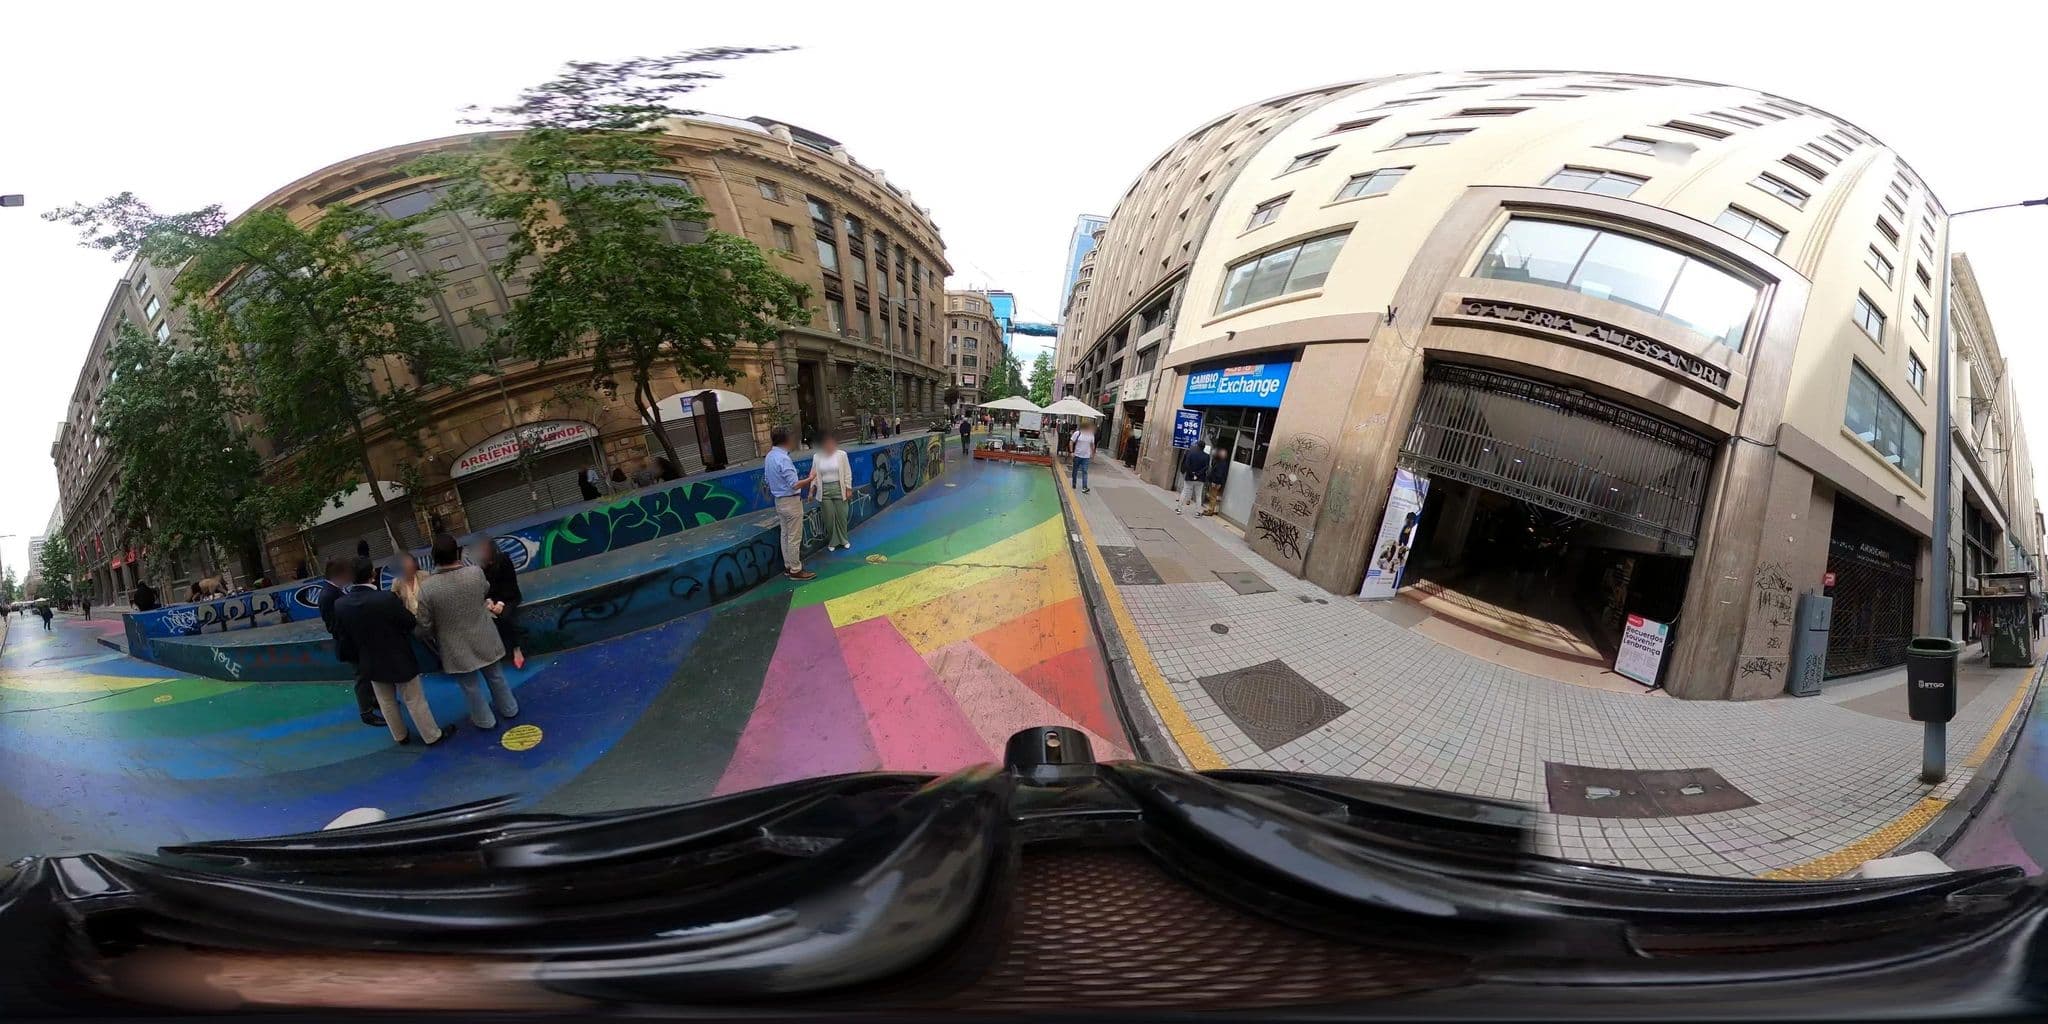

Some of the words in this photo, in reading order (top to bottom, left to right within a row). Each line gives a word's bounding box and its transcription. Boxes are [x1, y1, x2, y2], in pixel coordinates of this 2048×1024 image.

[1466, 303, 1577, 333] GALERIA
[1587, 325, 1721, 386] ALESSANDRI
[1191, 373, 1218, 385] CAMBIO
[1220, 376, 1280, 397] Exchange
[487, 439, 515, 452] pisos
[1625, 632, 1656, 647] Souvenir
[1626, 626, 1663, 643] Recuerdos
